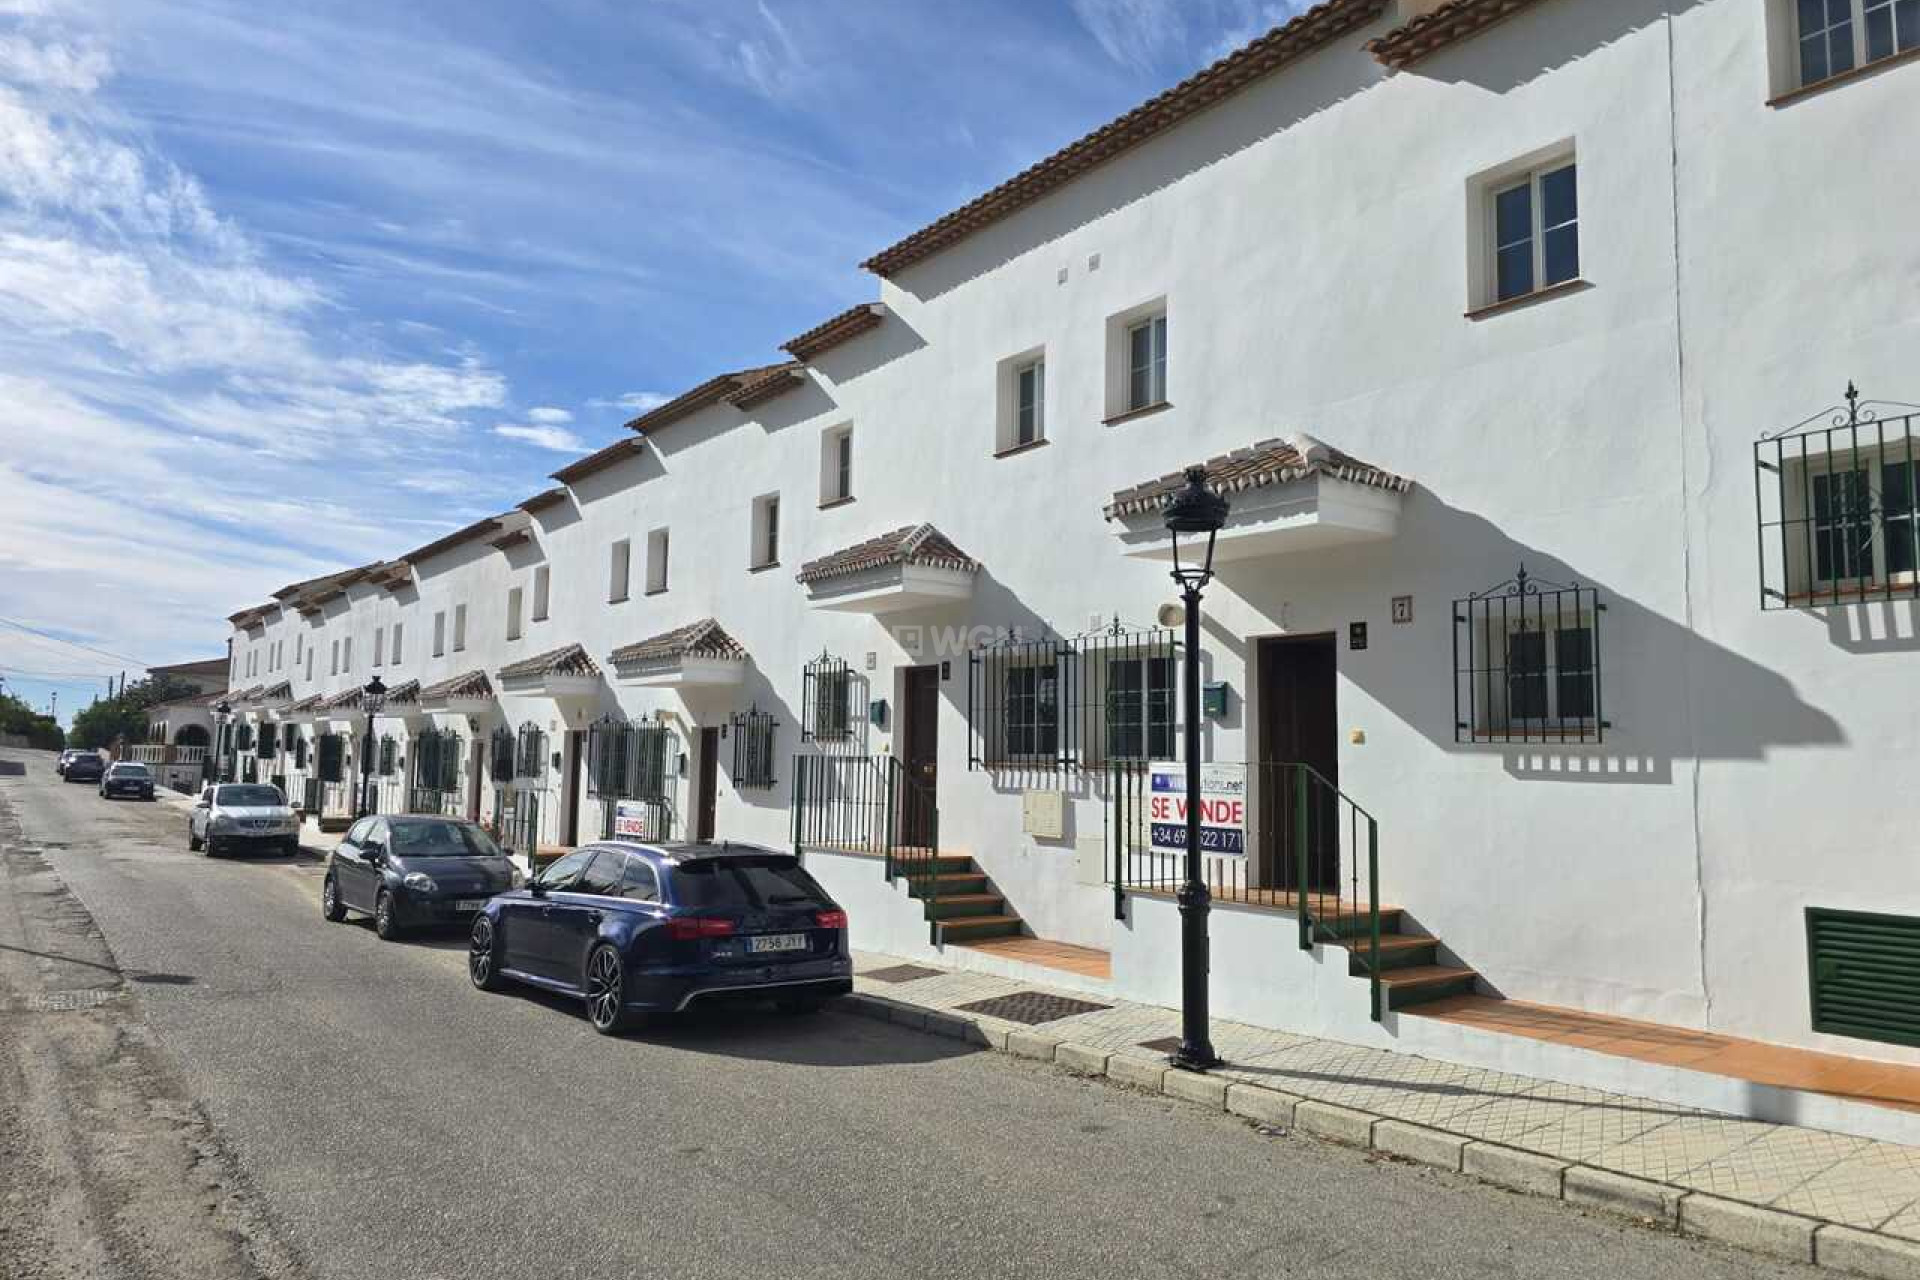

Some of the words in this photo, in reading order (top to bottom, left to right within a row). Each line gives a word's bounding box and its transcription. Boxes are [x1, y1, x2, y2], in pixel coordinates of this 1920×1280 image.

[1152, 797, 1169, 819] SE
[1176, 799, 1243, 823] VNDE
[1152, 827, 1171, 842] +34
